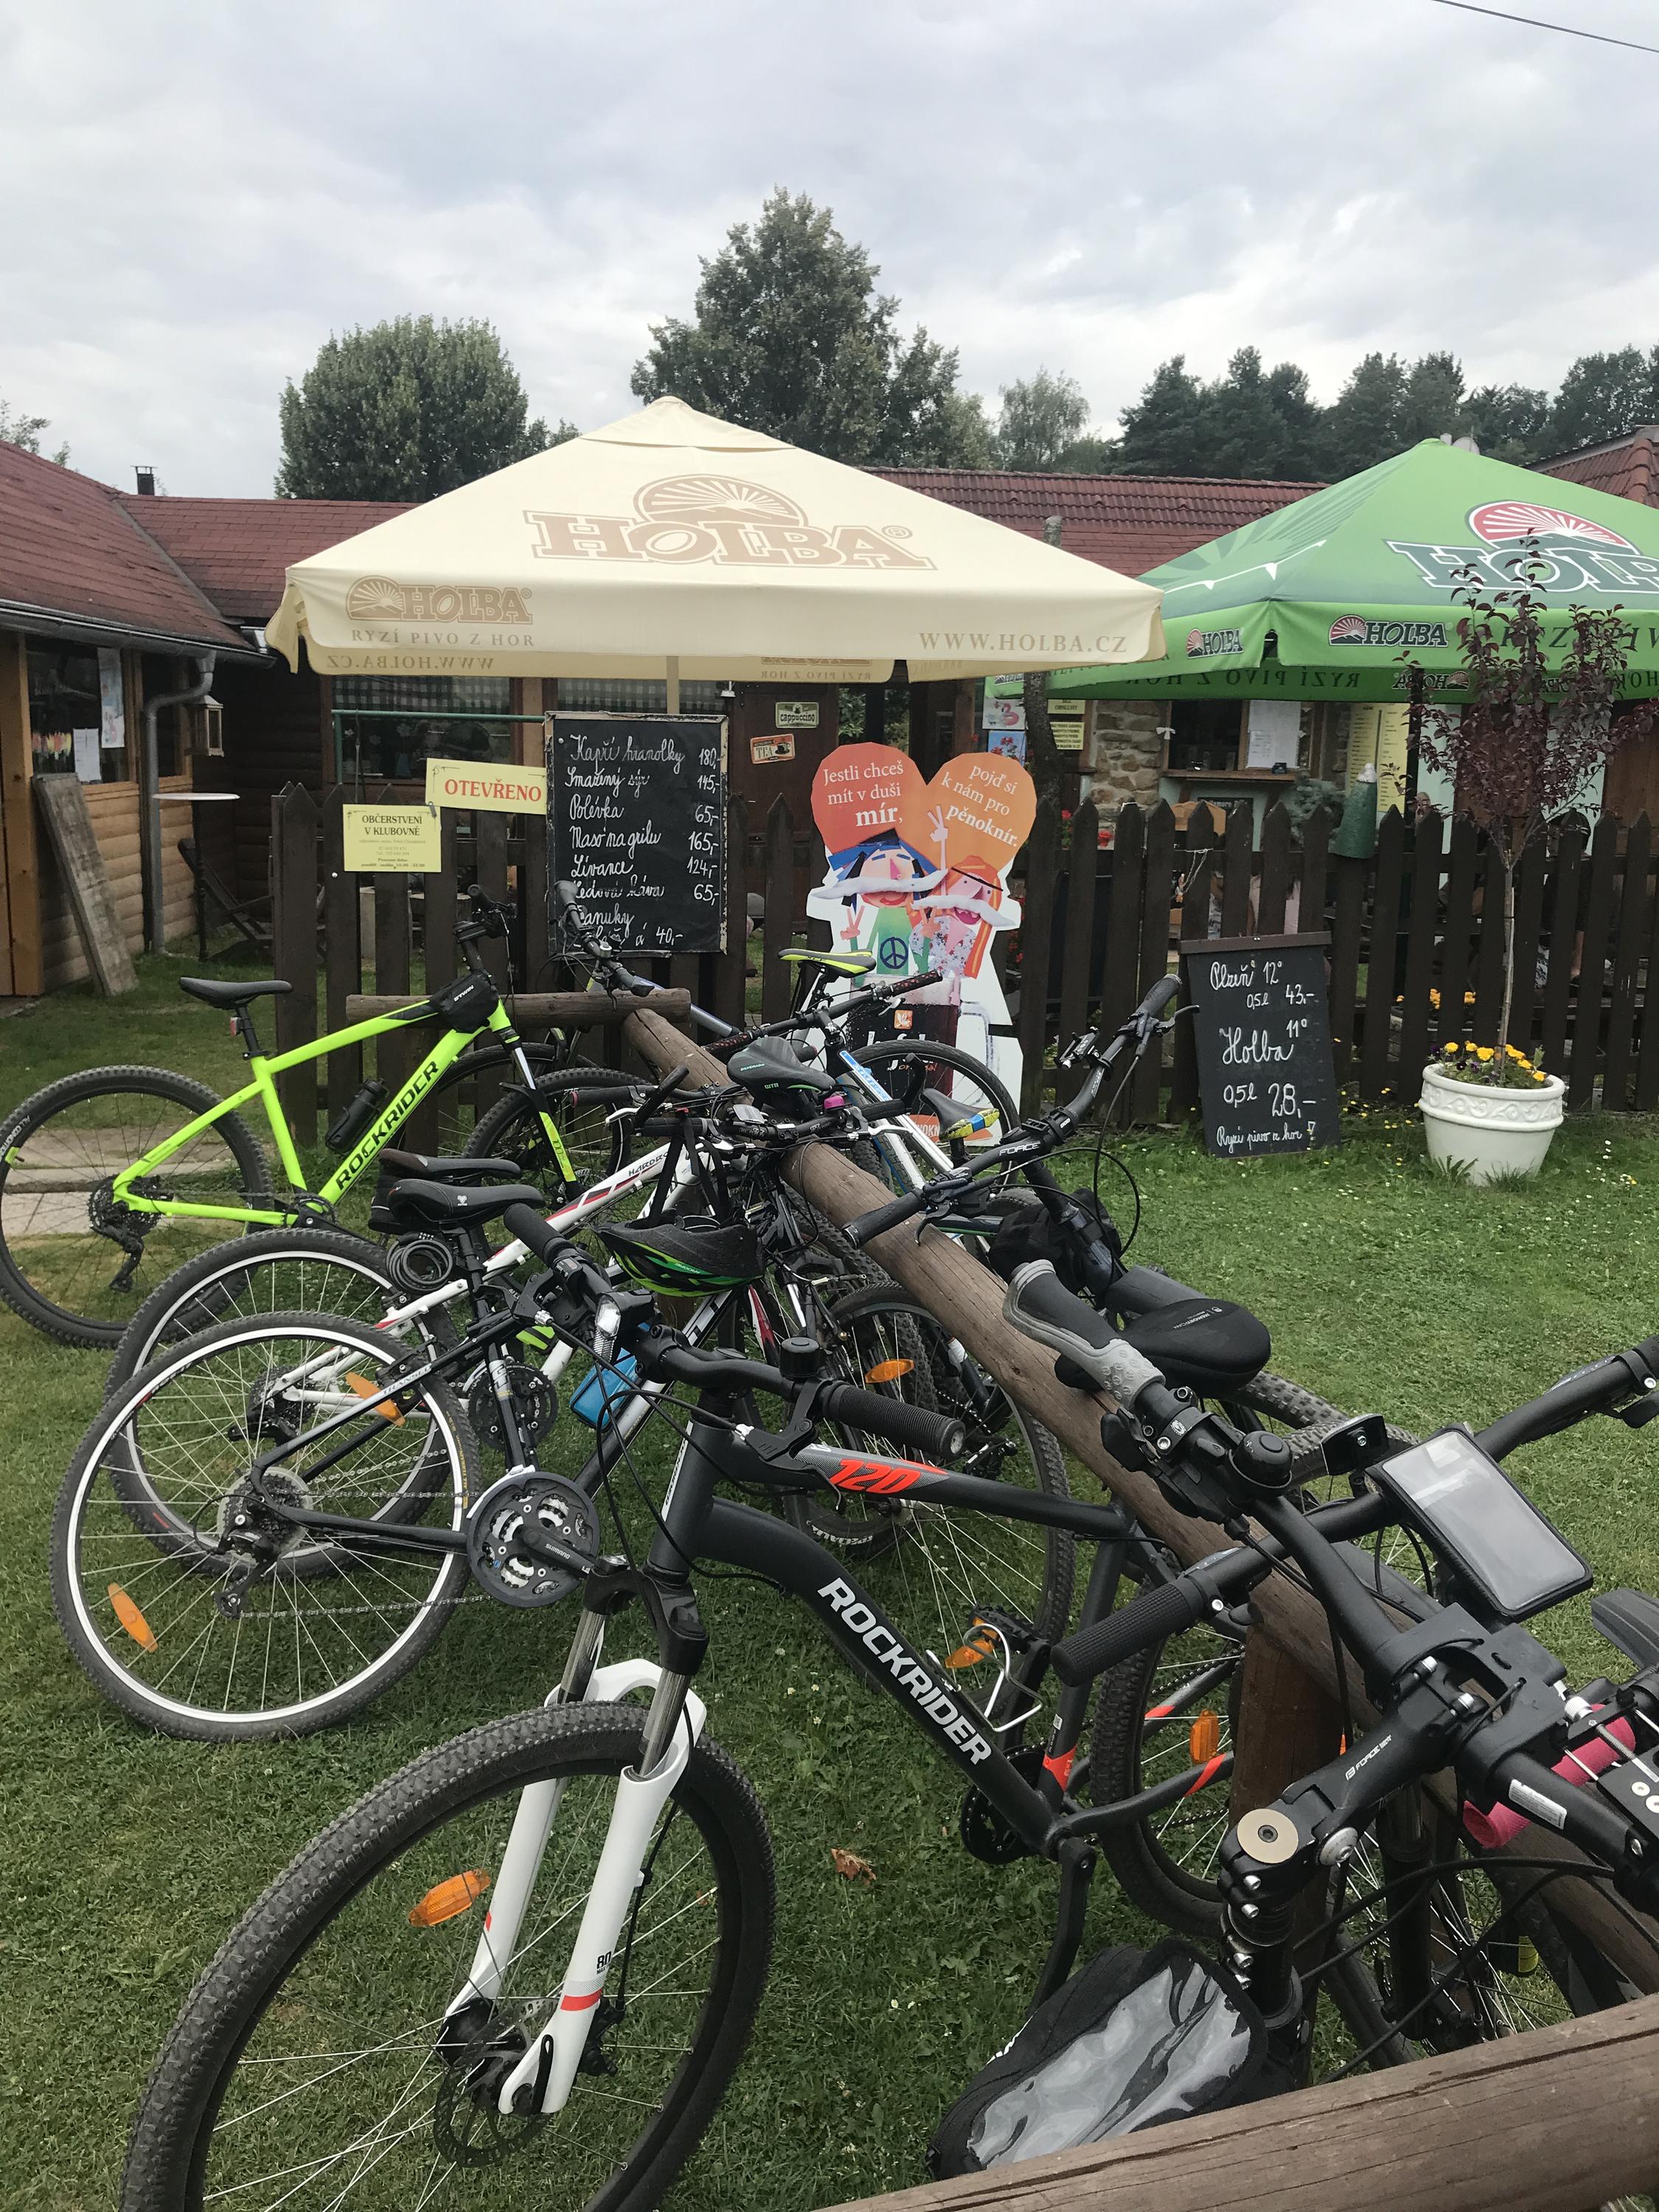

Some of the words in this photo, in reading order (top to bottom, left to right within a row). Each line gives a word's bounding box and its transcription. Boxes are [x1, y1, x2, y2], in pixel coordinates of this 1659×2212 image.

[352, 628, 400, 644] RYZÍ
[411, 632, 459, 646] PIVO
[470, 633, 481, 646] Z
[491, 633, 535, 647] HOR
[919, 632, 1127, 653] WWW.HOLBA.CZ
[1200, 629, 1244, 655] HOLBA
[1363, 621, 1448, 647] HOLBA
[780, 712, 815, 723] cappuccino
[622, 736, 686, 774] hranolky
[823, 764, 860, 786] Jestli
[863, 760, 904, 778] chceš
[968, 765, 1005, 789] pojď
[1004, 782, 1018, 796] si
[444, 778, 542, 802] OTEVŘENO
[827, 788, 854, 805] mít
[858, 789, 867, 801] v
[870, 782, 901, 800] duši
[941, 772, 950, 787] k
[953, 782, 984, 804] nám
[985, 800, 1010, 816] pro
[361, 813, 422, 825] OBČERSTVENÍ
[569, 793, 625, 820] Polévka
[855, 802, 903, 827] mír,
[364, 827, 371, 835] V
[373, 825, 420, 836] KLUBOVNĚ
[945, 804, 1018, 847] pěnoknír.
[627, 819, 662, 859] grilu
[1209, 961, 1255, 991] Plzeň
[1219, 1026, 1294, 1065] Holba
[335, 1060, 439, 1191] ROCKRIDER
[1247, 1130, 1271, 1151] pivo
[1281, 1121, 1303, 1141] hor
[998, 1140, 1041, 1157] FORCE
[829, 1458, 922, 1494] 120
[545, 1543, 571, 1560] SHIMANO
[817, 1576, 992, 1765] ROCKRIDER
[1355, 1745, 1381, 1770] FORCE
